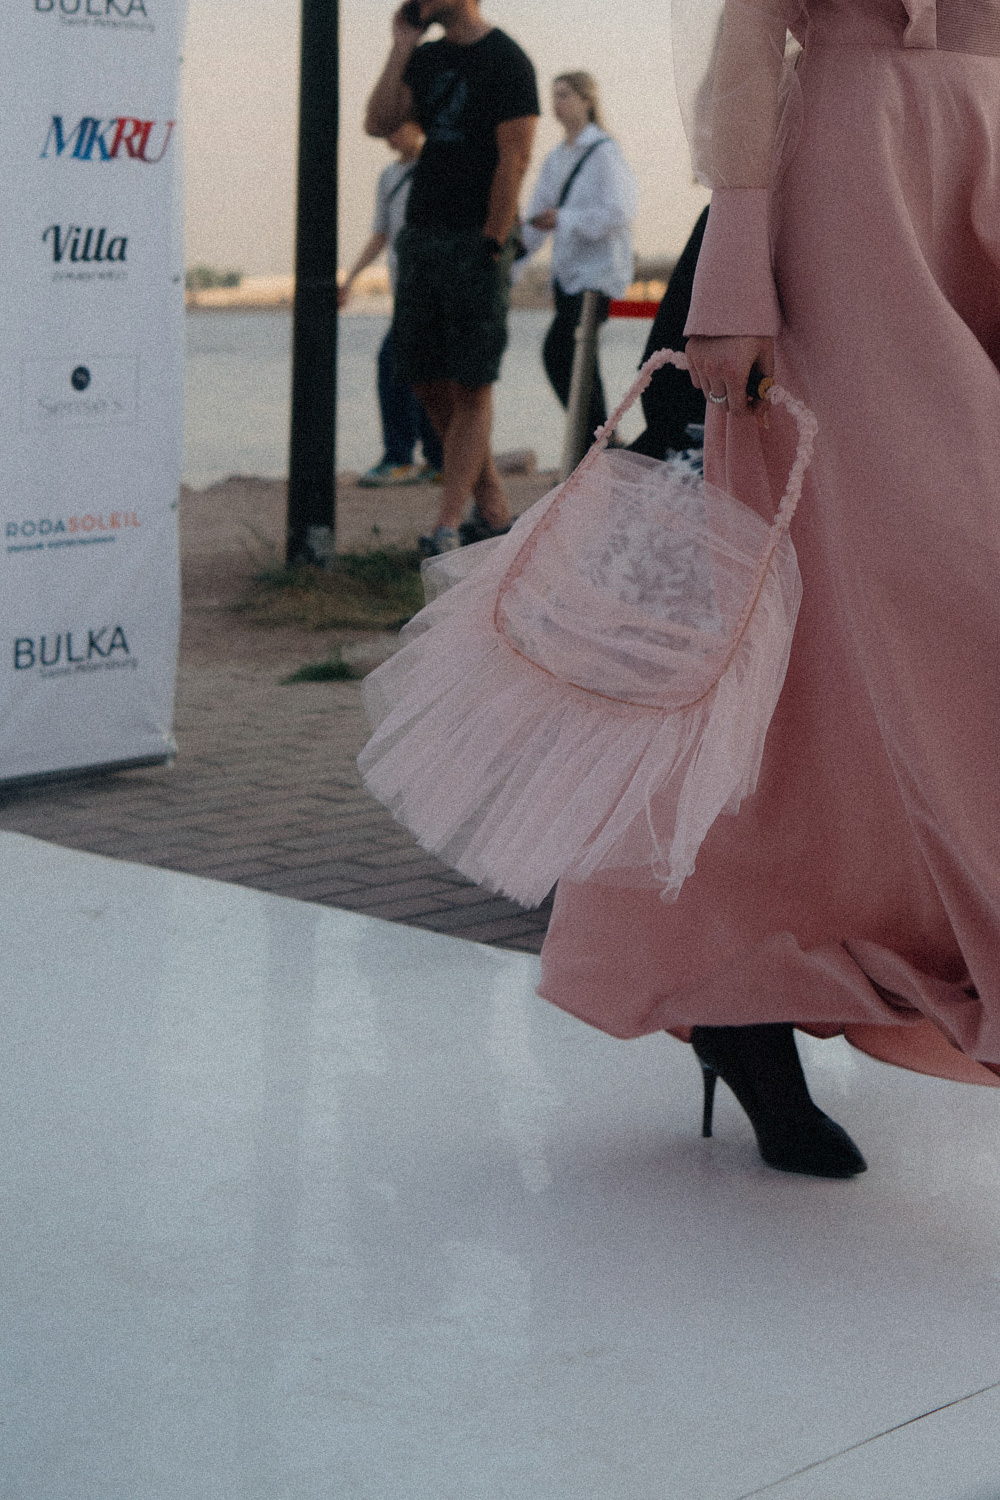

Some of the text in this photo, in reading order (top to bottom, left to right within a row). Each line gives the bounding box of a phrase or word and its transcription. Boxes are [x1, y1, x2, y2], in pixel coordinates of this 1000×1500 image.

[40, 115, 176, 164] MKRU
[41, 224, 128, 263] Villa
[14, 625, 130, 671] BULKA
